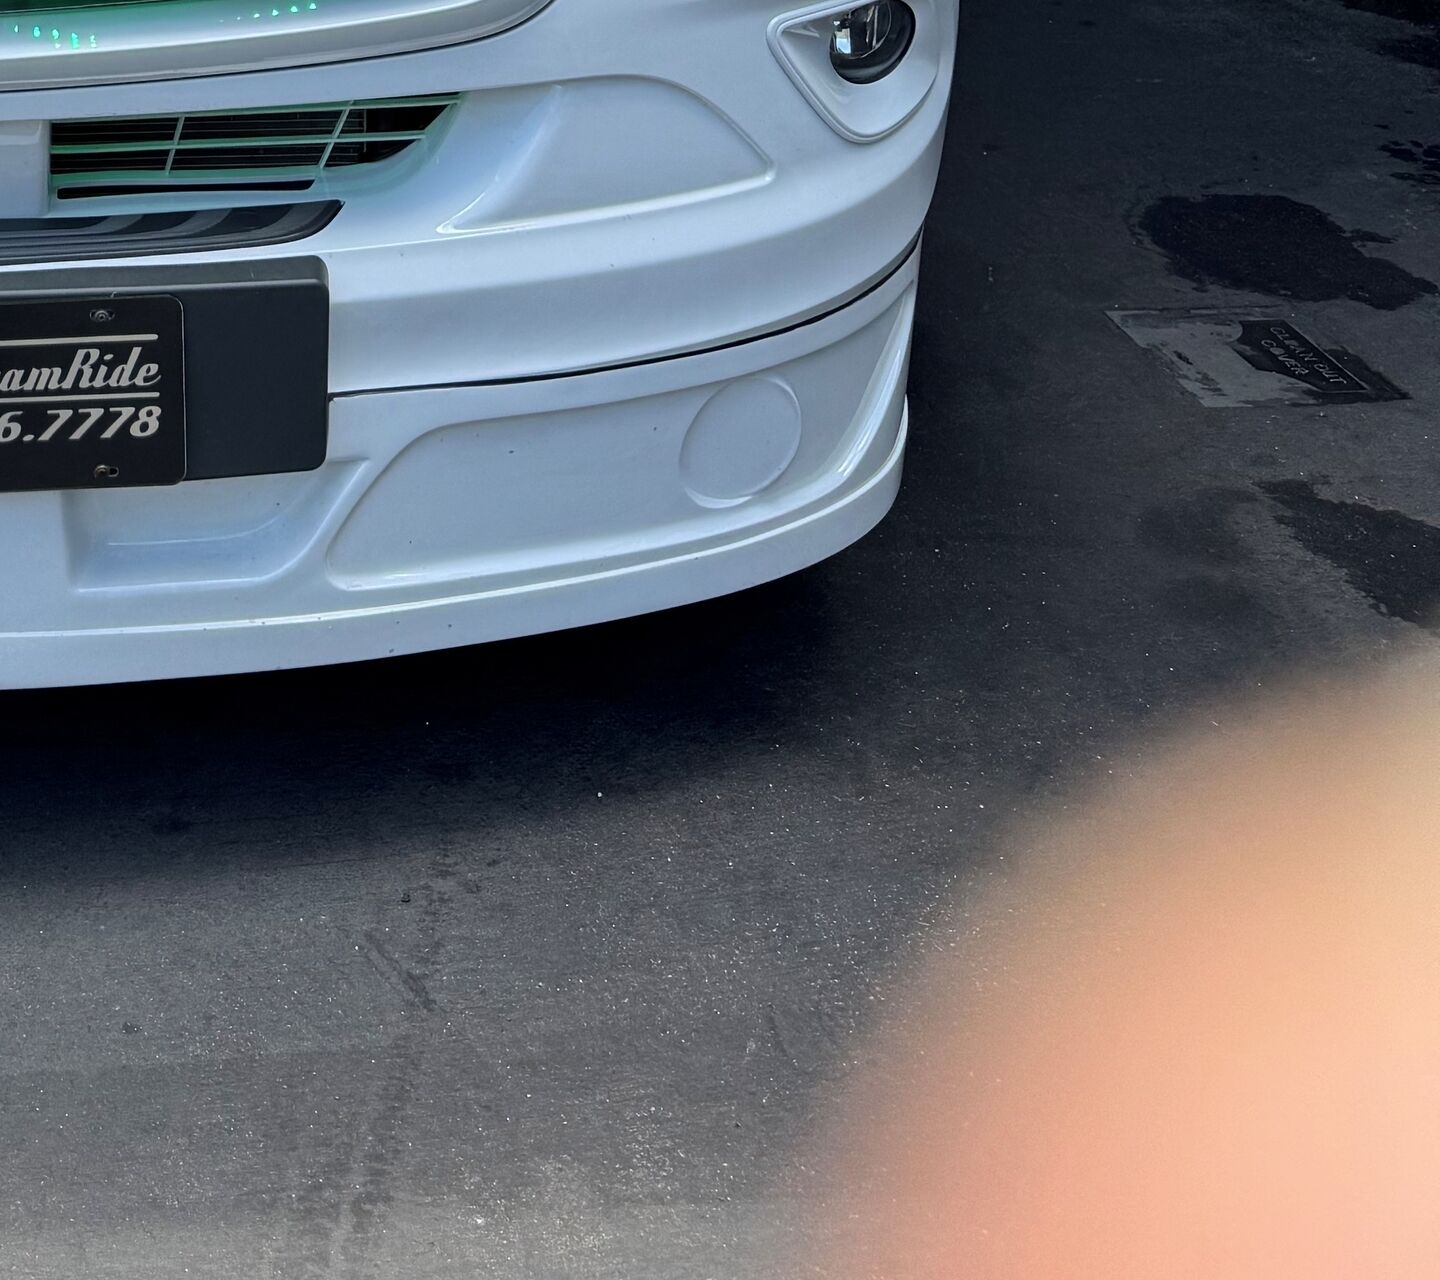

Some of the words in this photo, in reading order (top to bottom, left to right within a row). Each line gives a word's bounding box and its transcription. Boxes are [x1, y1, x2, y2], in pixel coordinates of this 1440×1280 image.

[1261, 339, 1310, 376] COVER
[1270, 326, 1319, 361] CLEAN
[1313, 363, 1348, 385] OUT
